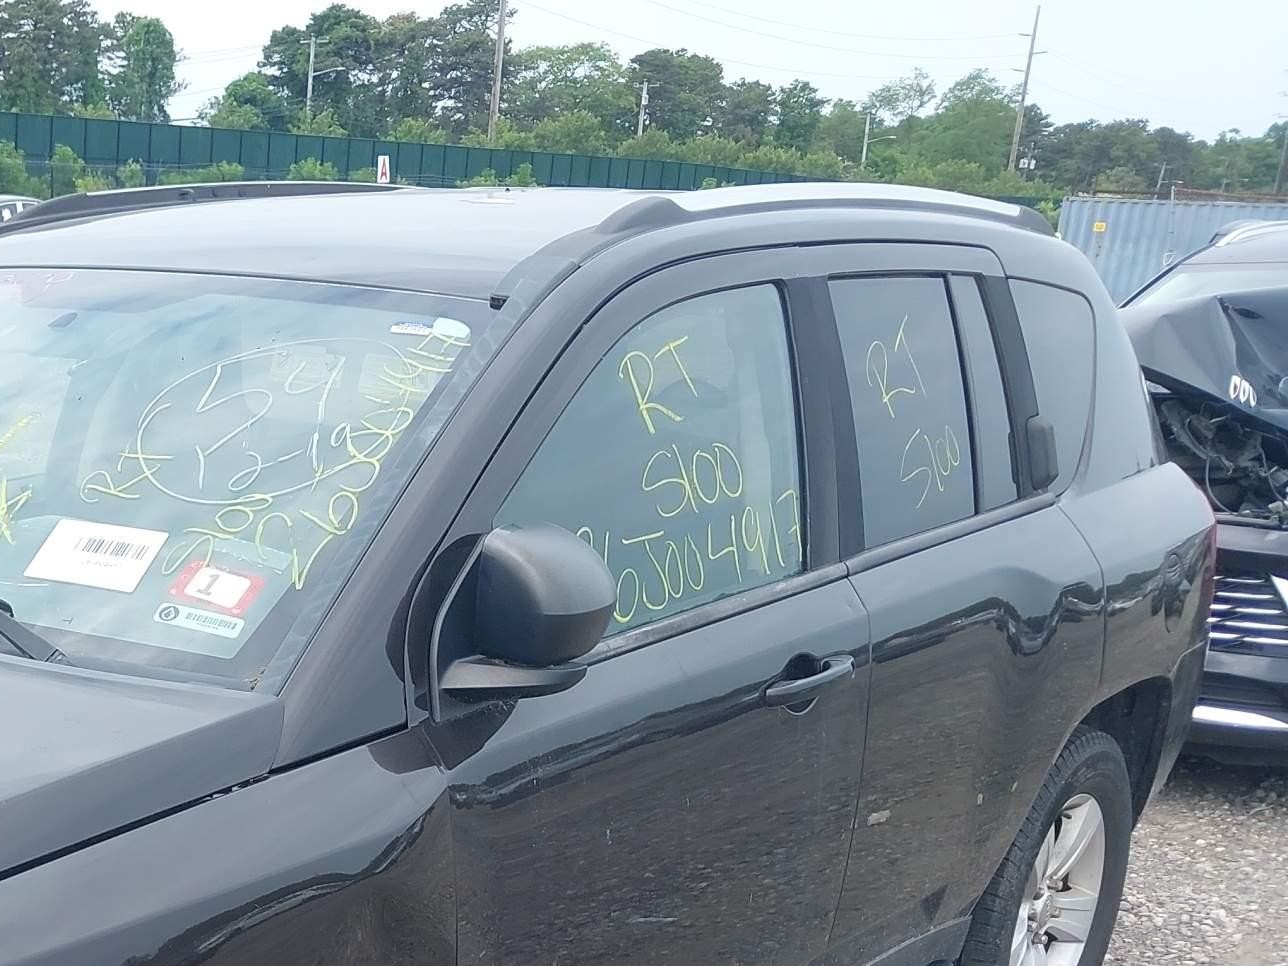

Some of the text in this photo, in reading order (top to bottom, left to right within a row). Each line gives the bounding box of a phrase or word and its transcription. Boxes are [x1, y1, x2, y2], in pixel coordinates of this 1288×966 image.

[379, 157, 388, 181] A
[619, 336, 698, 434] RT
[196, 574, 220, 596] 1
